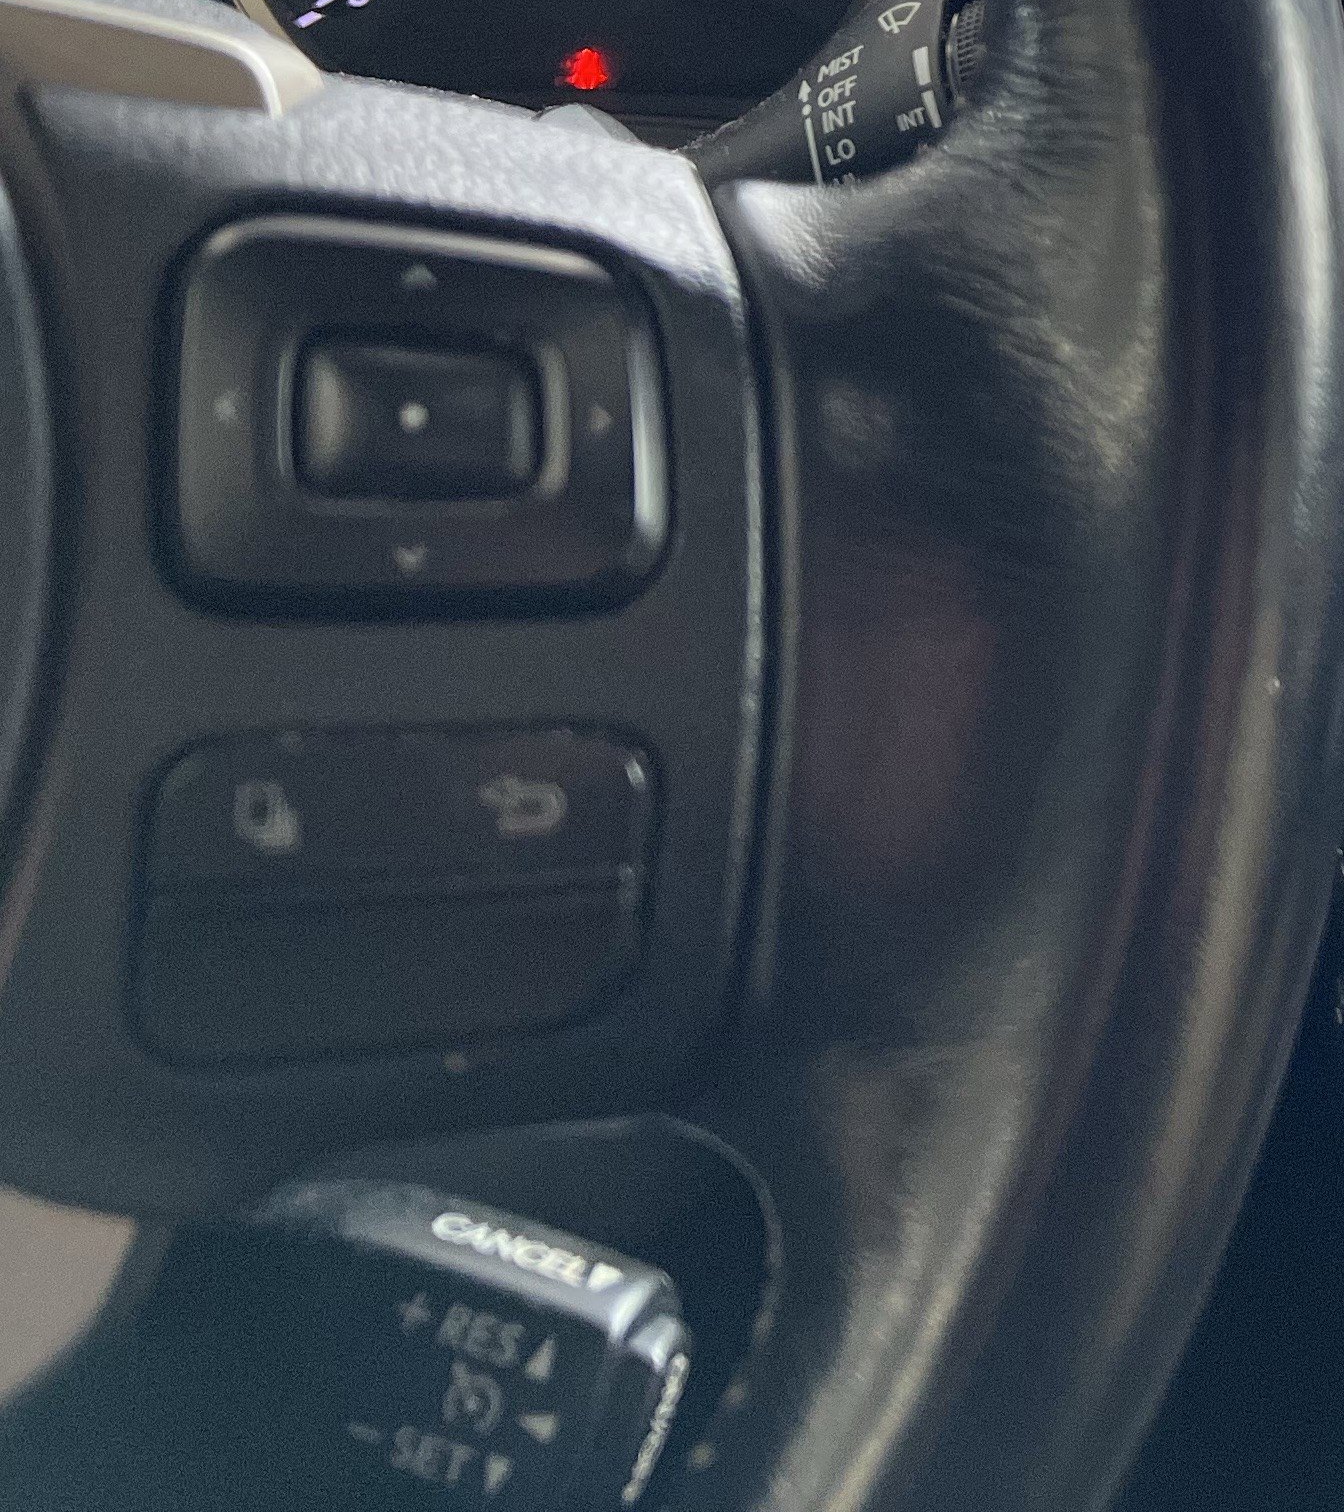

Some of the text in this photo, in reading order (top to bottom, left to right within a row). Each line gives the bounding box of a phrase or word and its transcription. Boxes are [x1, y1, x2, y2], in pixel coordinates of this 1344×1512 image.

[817, 44, 865, 83] MIST
[816, 74, 858, 108] OFF
[821, 99, 857, 135] INT
[895, 106, 927, 133] INT
[824, 138, 856, 166] LO
